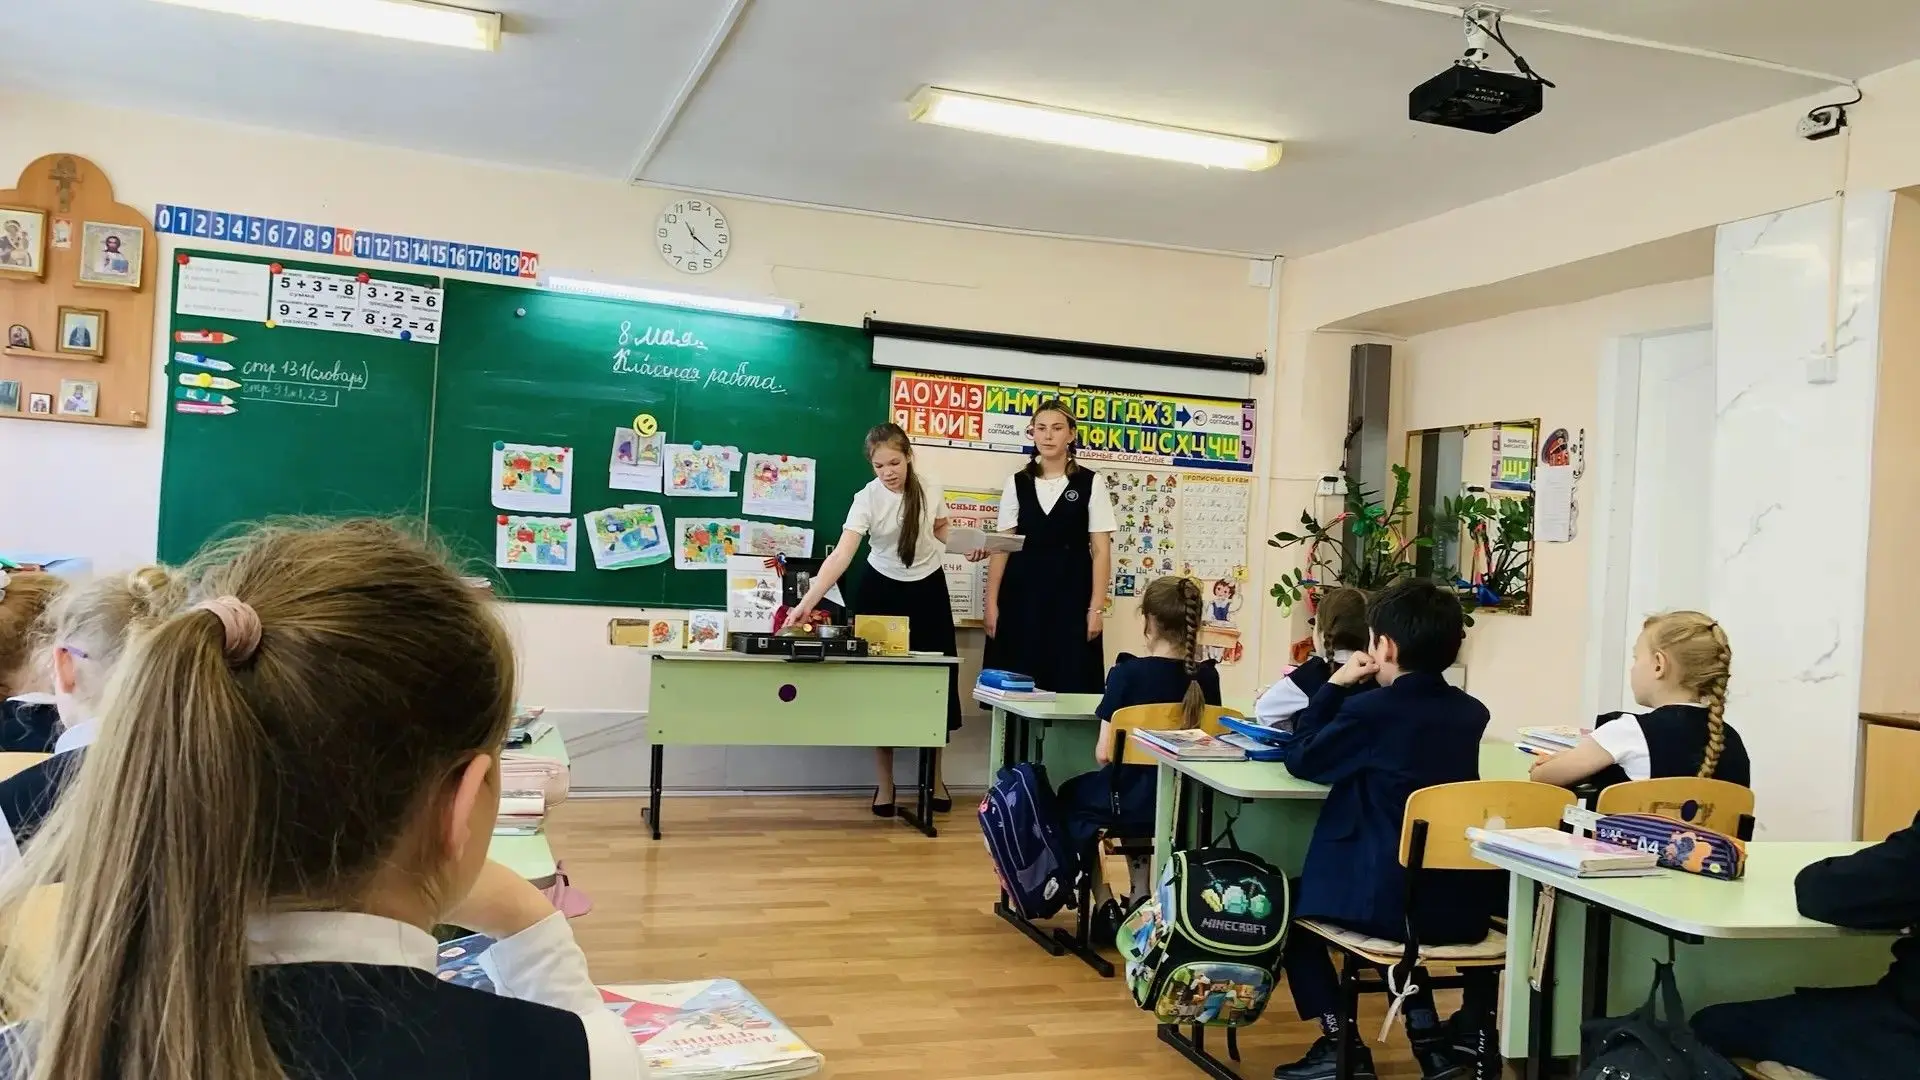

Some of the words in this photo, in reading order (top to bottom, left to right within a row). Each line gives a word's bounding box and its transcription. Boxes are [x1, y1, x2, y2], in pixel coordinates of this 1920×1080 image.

[675, 204, 682, 214] 11
[687, 201, 702, 211] 12
[706, 207, 711, 216] 1
[665, 214, 676, 224] 10
[714, 218, 724, 228] 2
[658, 228, 668, 238] 9
[718, 234, 728, 244] 3
[158, 210, 170, 228] 0
[178, 212, 187, 231] 1
[195, 214, 206, 234] 2
[214, 216, 224, 236] 3
[232, 220, 243, 238] 4
[250, 222, 261, 240] 5
[268, 224, 278, 243] 6
[286, 226, 296, 245] 7
[304, 228, 314, 248] 8
[321, 231, 332, 249] 9
[337, 233, 352, 252] 10
[356, 236, 371, 254] 11
[375, 238, 390, 256] 12
[394, 240, 408, 258] 13
[413, 243, 428, 261] 14
[432, 245, 446, 264] 15
[450, 247, 464, 266] 16
[468, 250, 482, 267] 17
[486, 252, 500, 270] 18
[504, 254, 518, 272] 19
[522, 256, 536, 274] 20
[662, 244, 672, 254] 8
[714, 250, 722, 258] 4
[674, 256, 682, 265] 7
[688, 262, 697, 270] 6
[704, 258, 712, 268] 5
[281, 277, 290, 288] 5
[313, 281, 322, 292] 3
[345, 284, 354, 295] 8
[368, 287, 376, 298] 3
[394, 291, 404, 302] 2
[426, 296, 436, 307] 6
[280, 304, 290, 315] 9
[308, 308, 318, 318] 2
[342, 310, 351, 321] 7
[366, 314, 374, 324] 8
[382, 316, 386, 324] :
[392, 318, 402, 328] 2
[424, 322, 434, 333] 4
[618, 320, 630, 344] 8
[896, 381, 910, 402] А
[914, 382, 930, 404] О
[934, 384, 947, 405] У
[950, 386, 966, 408] Ы
[969, 388, 982, 408] Э
[986, 388, 1002, 410] Й
[1005, 391, 1020, 413] Н
[1022, 393, 1038, 414] М
[1076, 398, 1088, 418] Б
[1093, 399, 1105, 420] В
[1112, 400, 1122, 420] Г
[1126, 402, 1140, 423] Д
[1142, 404, 1158, 424] Ж
[1161, 405, 1172, 425] З
[896, 410, 908, 431] Я
[915, 408, 926, 432] Ё
[930, 412, 946, 434] Ю
[949, 415, 964, 436] И
[969, 416, 980, 437] Е
[1077, 426, 1088, 446] П
[1090, 427, 1106, 448] Ф
[1109, 428, 1122, 449] К
[1127, 430, 1138, 450] Т
[1142, 432, 1156, 452] Ш
[1159, 433, 1172, 454] С
[1176, 434, 1189, 455] Х
[1192, 435, 1206, 456] Ц
[1209, 436, 1220, 457] Ч
[1223, 438, 1238, 461] Щ
[1080, 451, 1114, 460] ПАРНЫЕ
[1118, 454, 1165, 464] СОГЛАСНЫЕ
[1200, 918, 1268, 936] MINECRAFT
